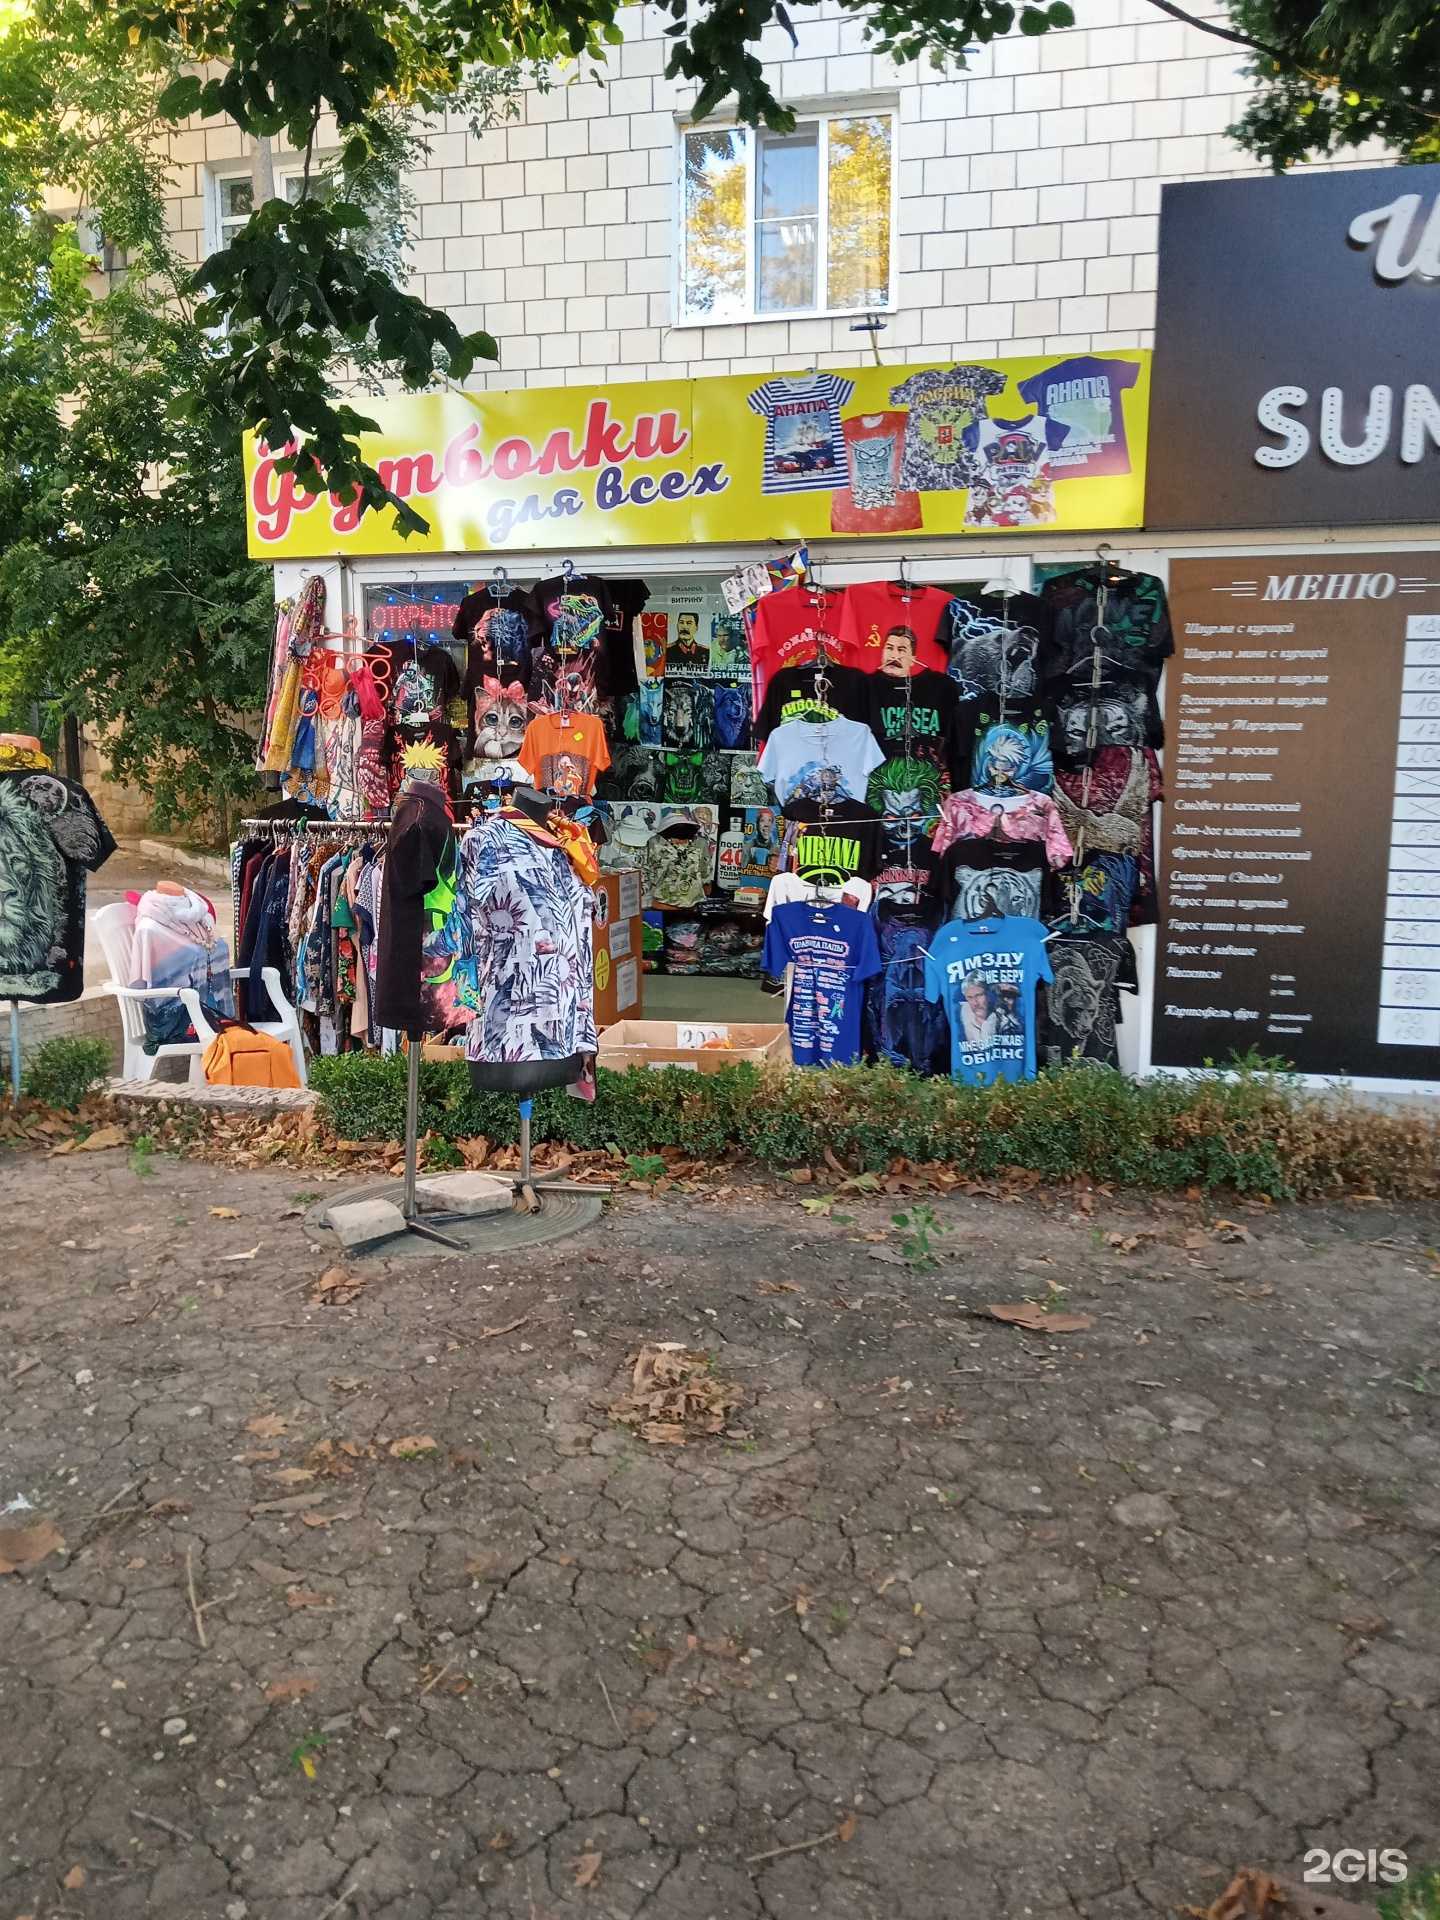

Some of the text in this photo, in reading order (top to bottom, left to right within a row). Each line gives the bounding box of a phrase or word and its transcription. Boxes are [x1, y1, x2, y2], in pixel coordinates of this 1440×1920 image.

[1047, 376, 1109, 405] АНАПА
[774, 399, 829, 417] АНАПА
[486, 466, 729, 543] для всех
[1261, 573, 1396, 601] МЕНЮ
[911, 707, 940, 733] SEA
[798, 835, 861, 871] NIRVANA
[946, 952, 1024, 983] Я МЗДУ
